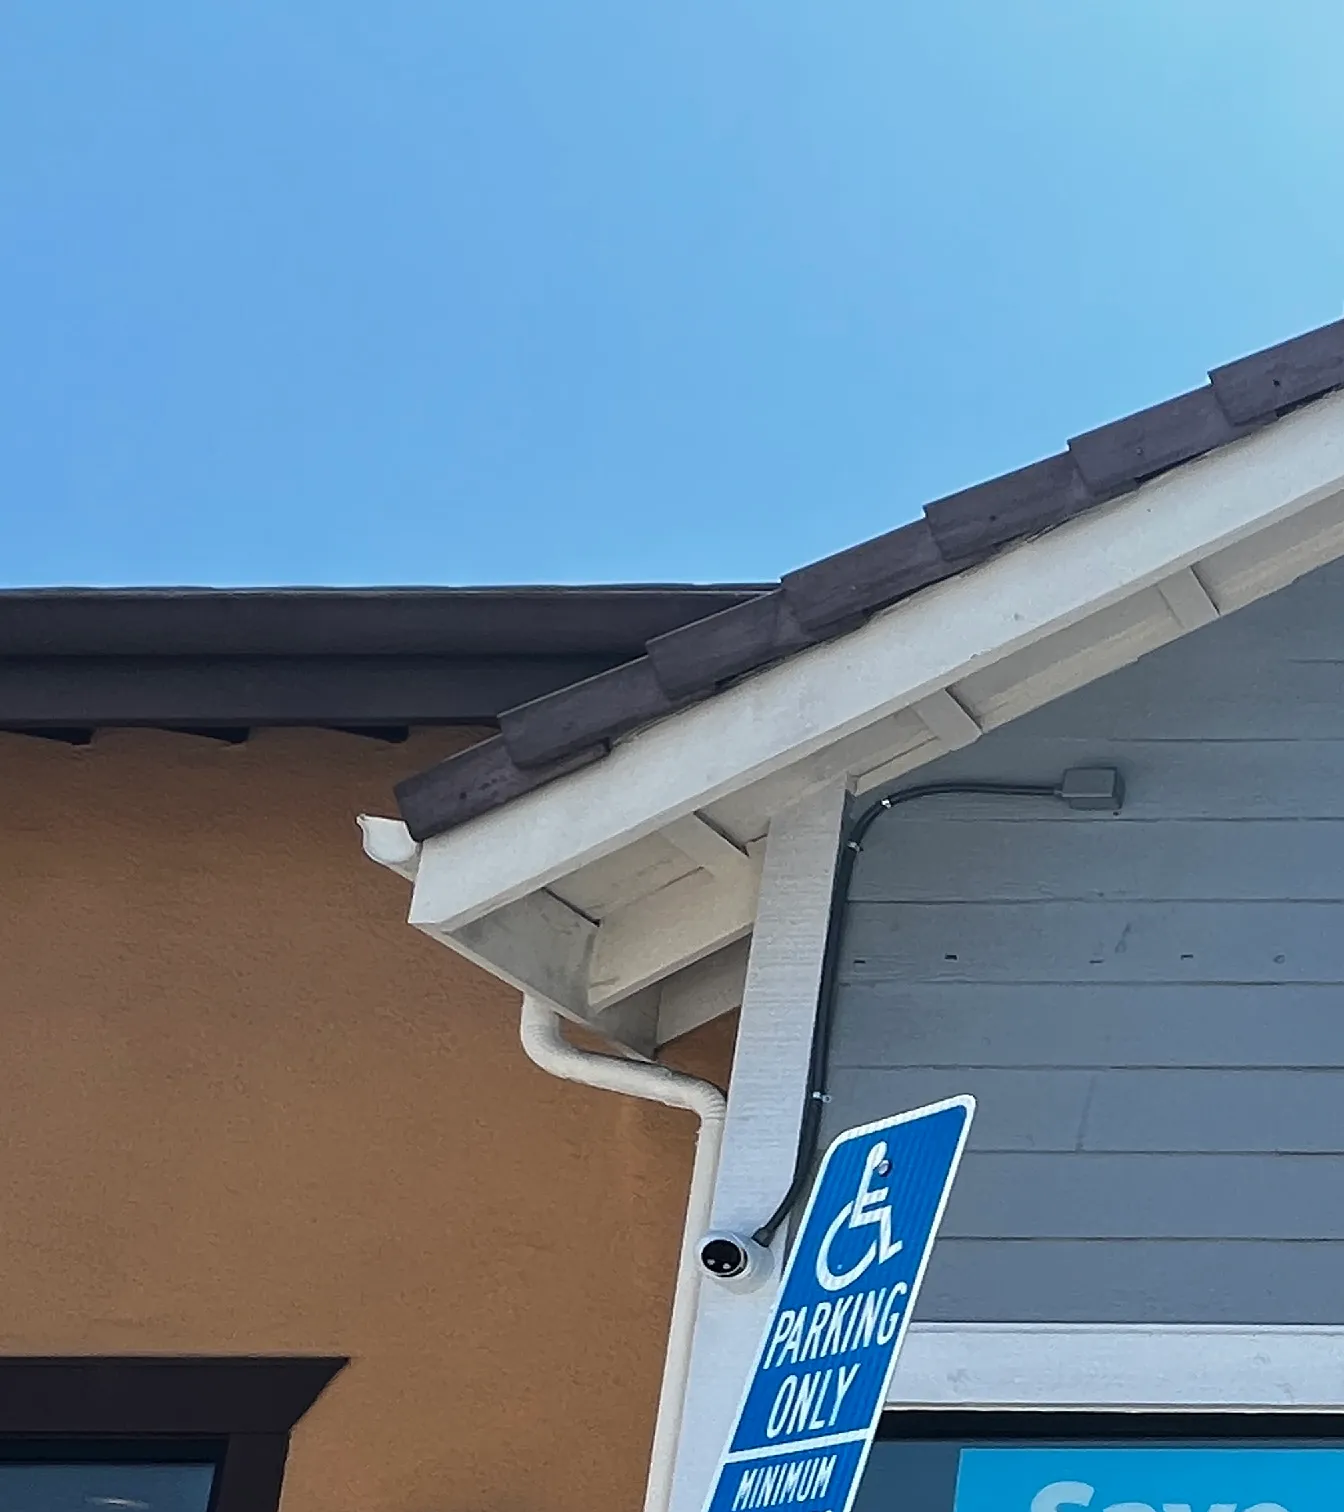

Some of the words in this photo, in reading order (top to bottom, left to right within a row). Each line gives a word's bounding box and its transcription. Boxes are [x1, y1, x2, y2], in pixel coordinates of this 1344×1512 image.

[764, 1281, 908, 1369] PARKING
[766, 1363, 860, 1438] ONLY
[731, 1455, 837, 1511] MINIMUM
